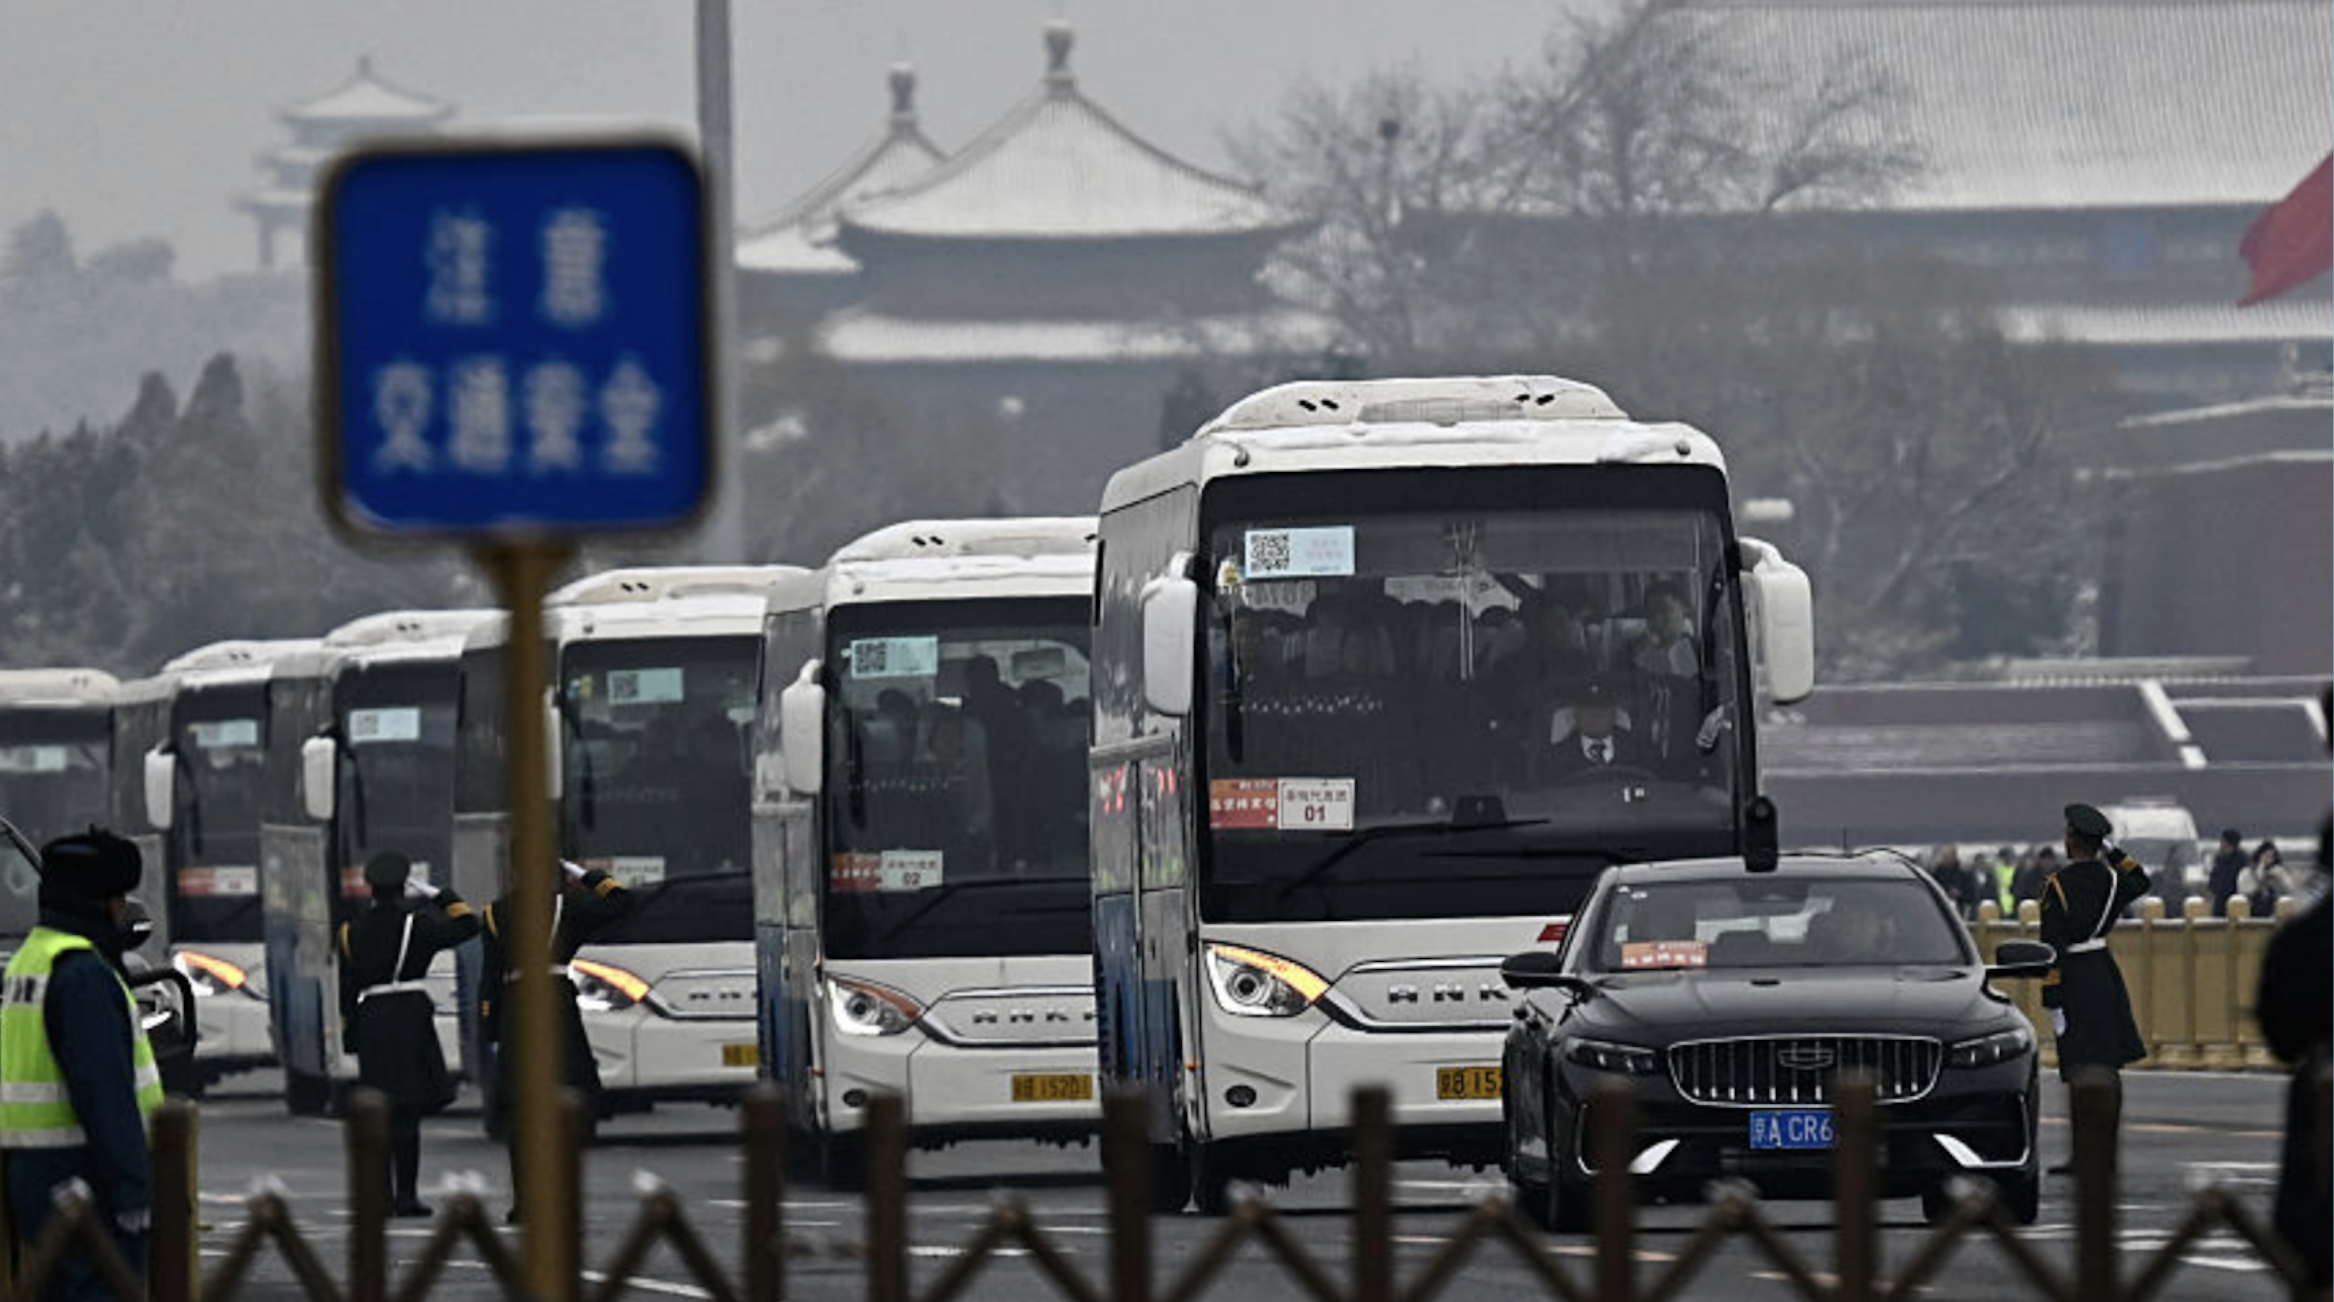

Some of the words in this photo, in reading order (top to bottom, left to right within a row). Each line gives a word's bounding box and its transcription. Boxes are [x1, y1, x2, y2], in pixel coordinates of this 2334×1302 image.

[426, 206, 606, 326] 注意
[372, 350, 662, 475] 交通安全
[1304, 804, 1326, 822] 01
[903, 871, 921, 886] 02
[1387, 983, 1509, 1003] ANK
[1788, 1115, 1834, 1142] CR6
